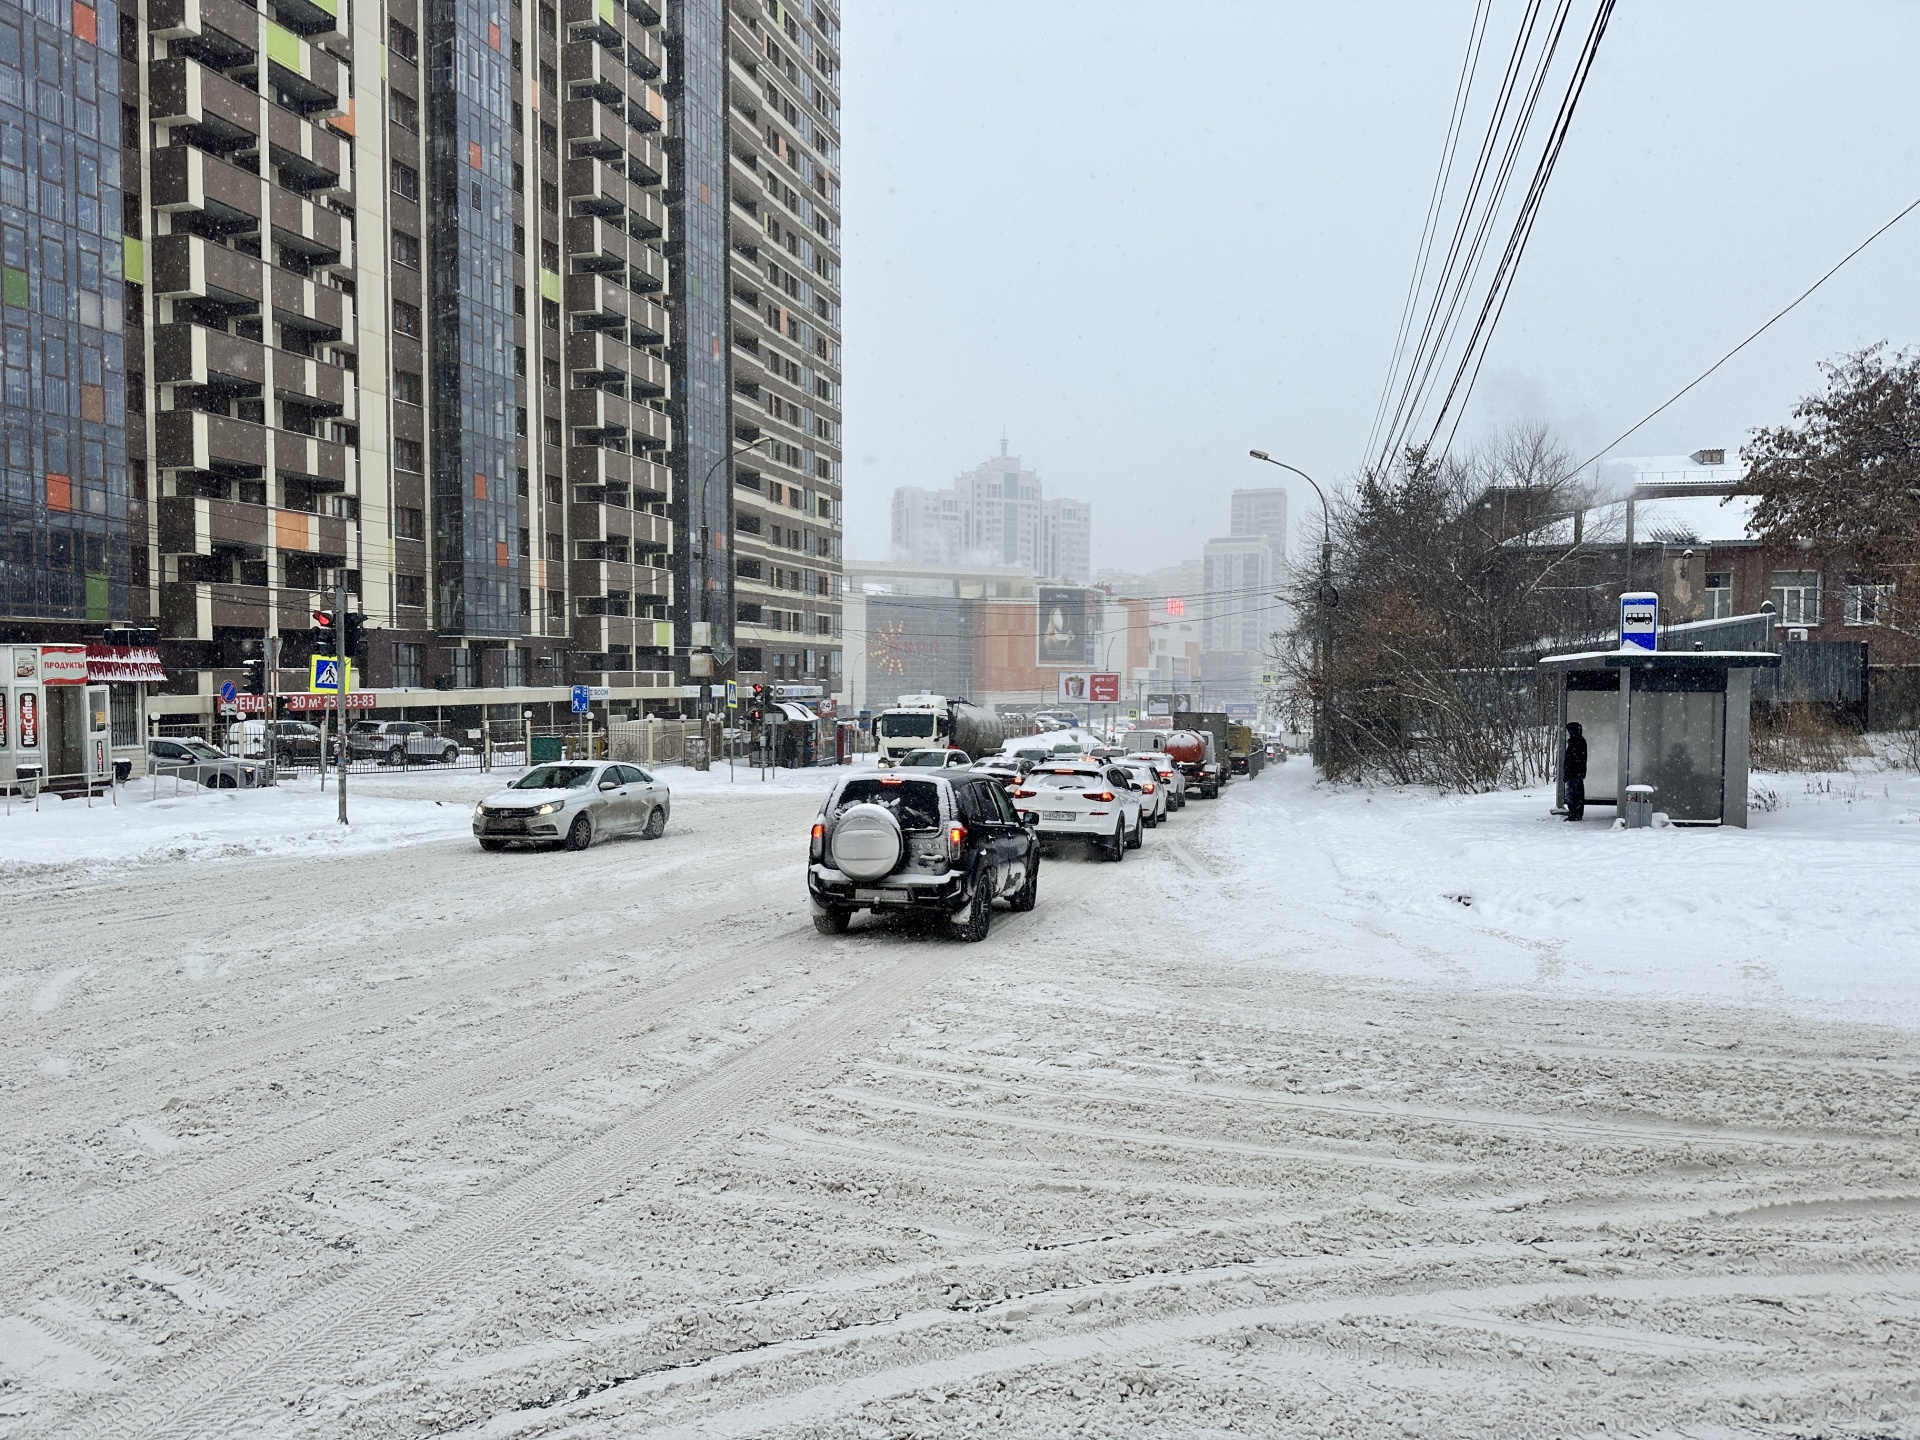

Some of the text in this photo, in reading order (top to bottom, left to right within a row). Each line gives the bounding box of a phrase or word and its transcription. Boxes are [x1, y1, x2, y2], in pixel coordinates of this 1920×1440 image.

[44, 661, 85, 669] ПРОДУКТЫ
[292, 696, 306, 709] 30
[23, 695, 35, 744] MacCoffee
